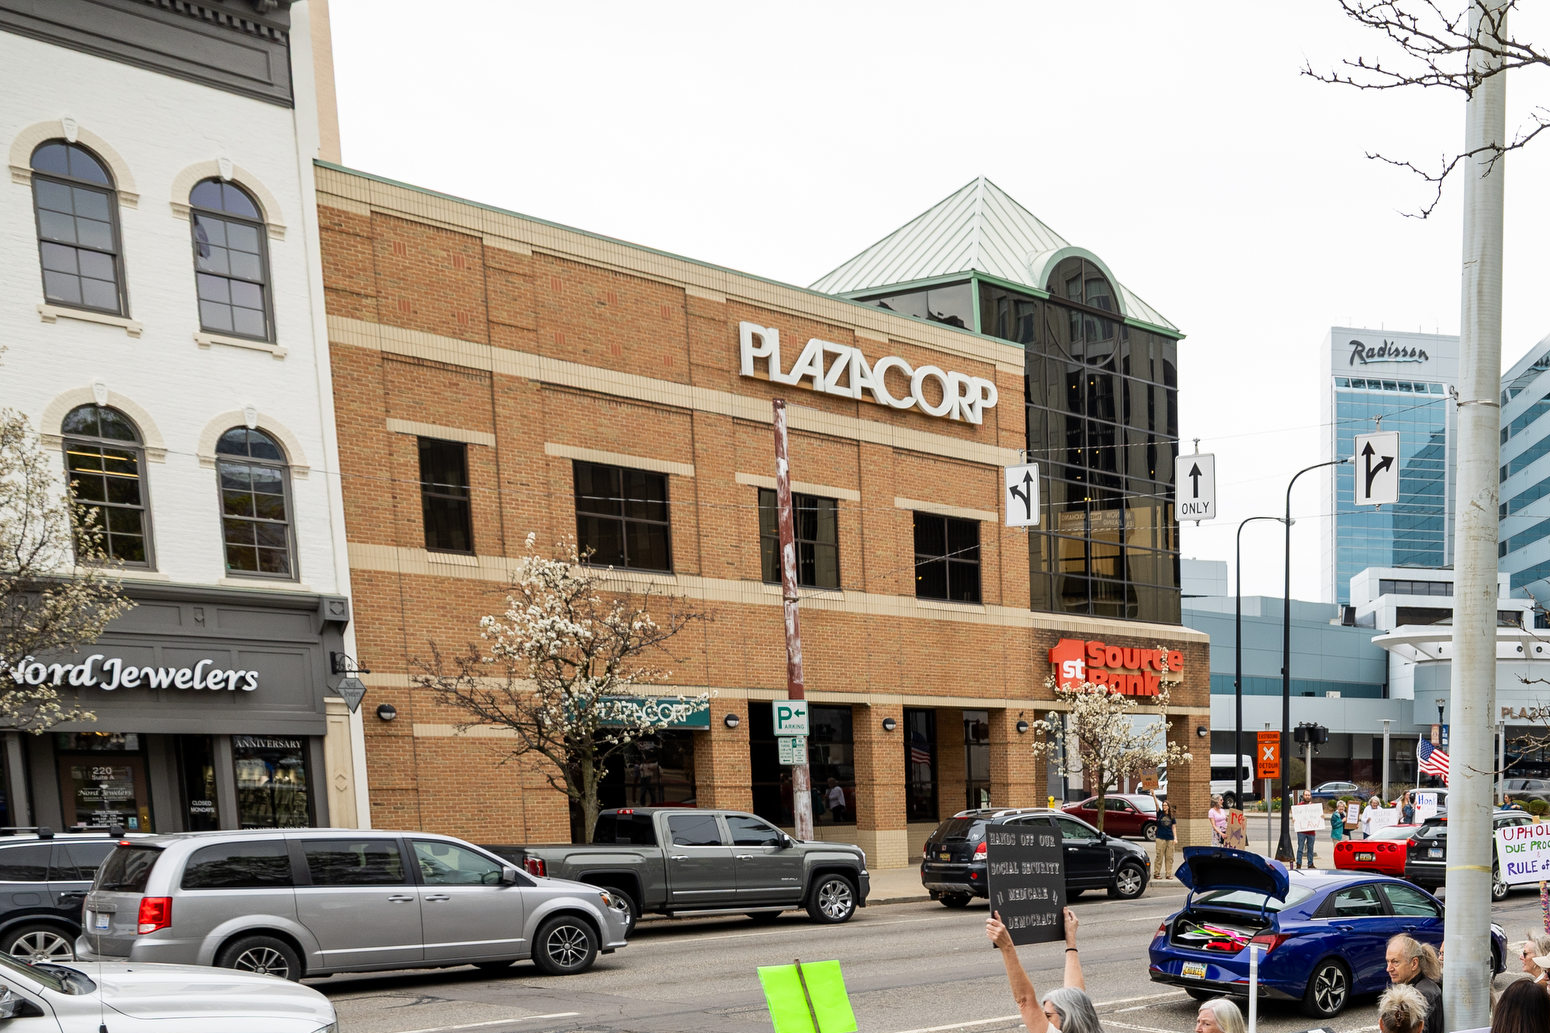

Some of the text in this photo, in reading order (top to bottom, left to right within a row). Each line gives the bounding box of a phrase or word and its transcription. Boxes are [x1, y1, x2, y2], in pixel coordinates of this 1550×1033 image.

[1349, 339, 1429, 367] Radisson
[739, 321, 999, 425] PLAZACORP
[1181, 502, 1209, 514] ONLY
[1085, 641, 1184, 671] Source
[100, 657, 259, 691] Jewelers
[1086, 669, 1162, 696] Bank
[236, 740, 301, 748] ANNIVERSARY
[92, 767, 112, 775] 220
[989, 832, 1056, 848] HANDS OFF OUR
[1505, 843, 1526, 854] DUE
[991, 862, 1060, 876] SOCIAL SECURITY
[1507, 860, 1538, 876] RULE
[1541, 859, 1550, 870] of
[1008, 913, 1057, 930] DEMOCRACY
